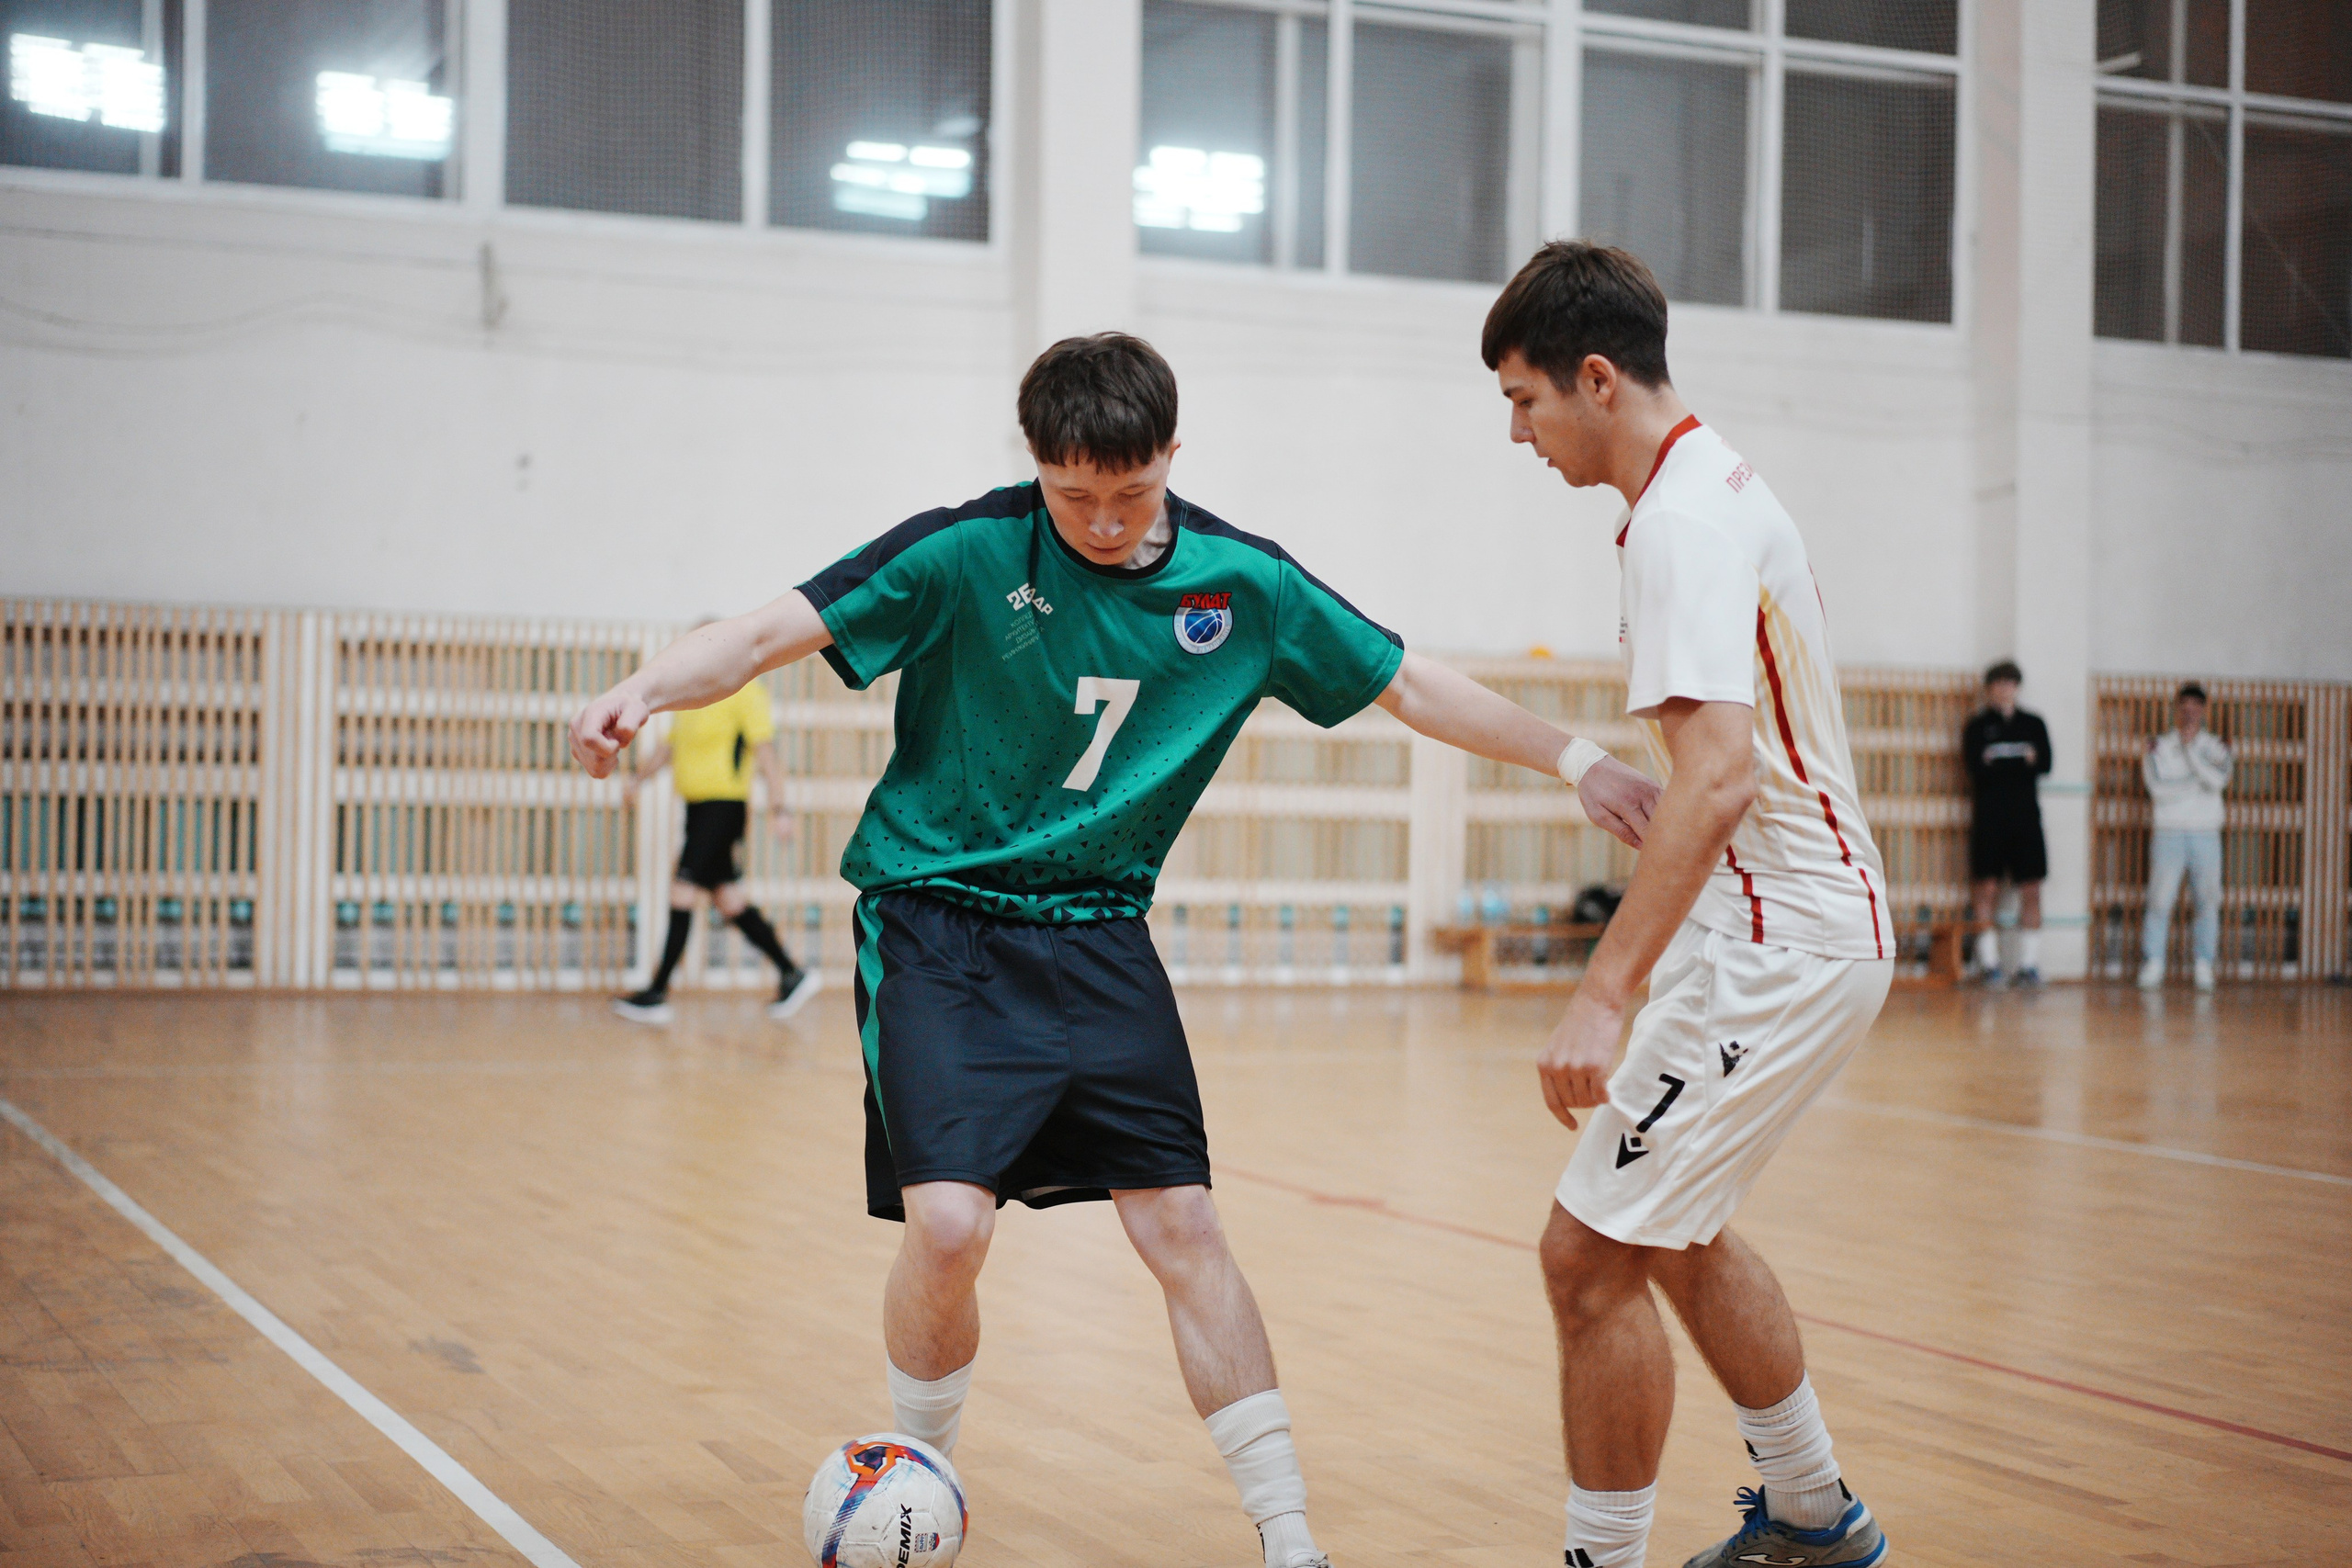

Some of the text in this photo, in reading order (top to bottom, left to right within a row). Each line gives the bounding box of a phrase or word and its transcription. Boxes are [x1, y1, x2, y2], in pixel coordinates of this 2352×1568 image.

[1180, 592, 1232, 610] БУЛАТ
[1062, 676, 1140, 792] 7
[1636, 1073, 1686, 1133] 7
